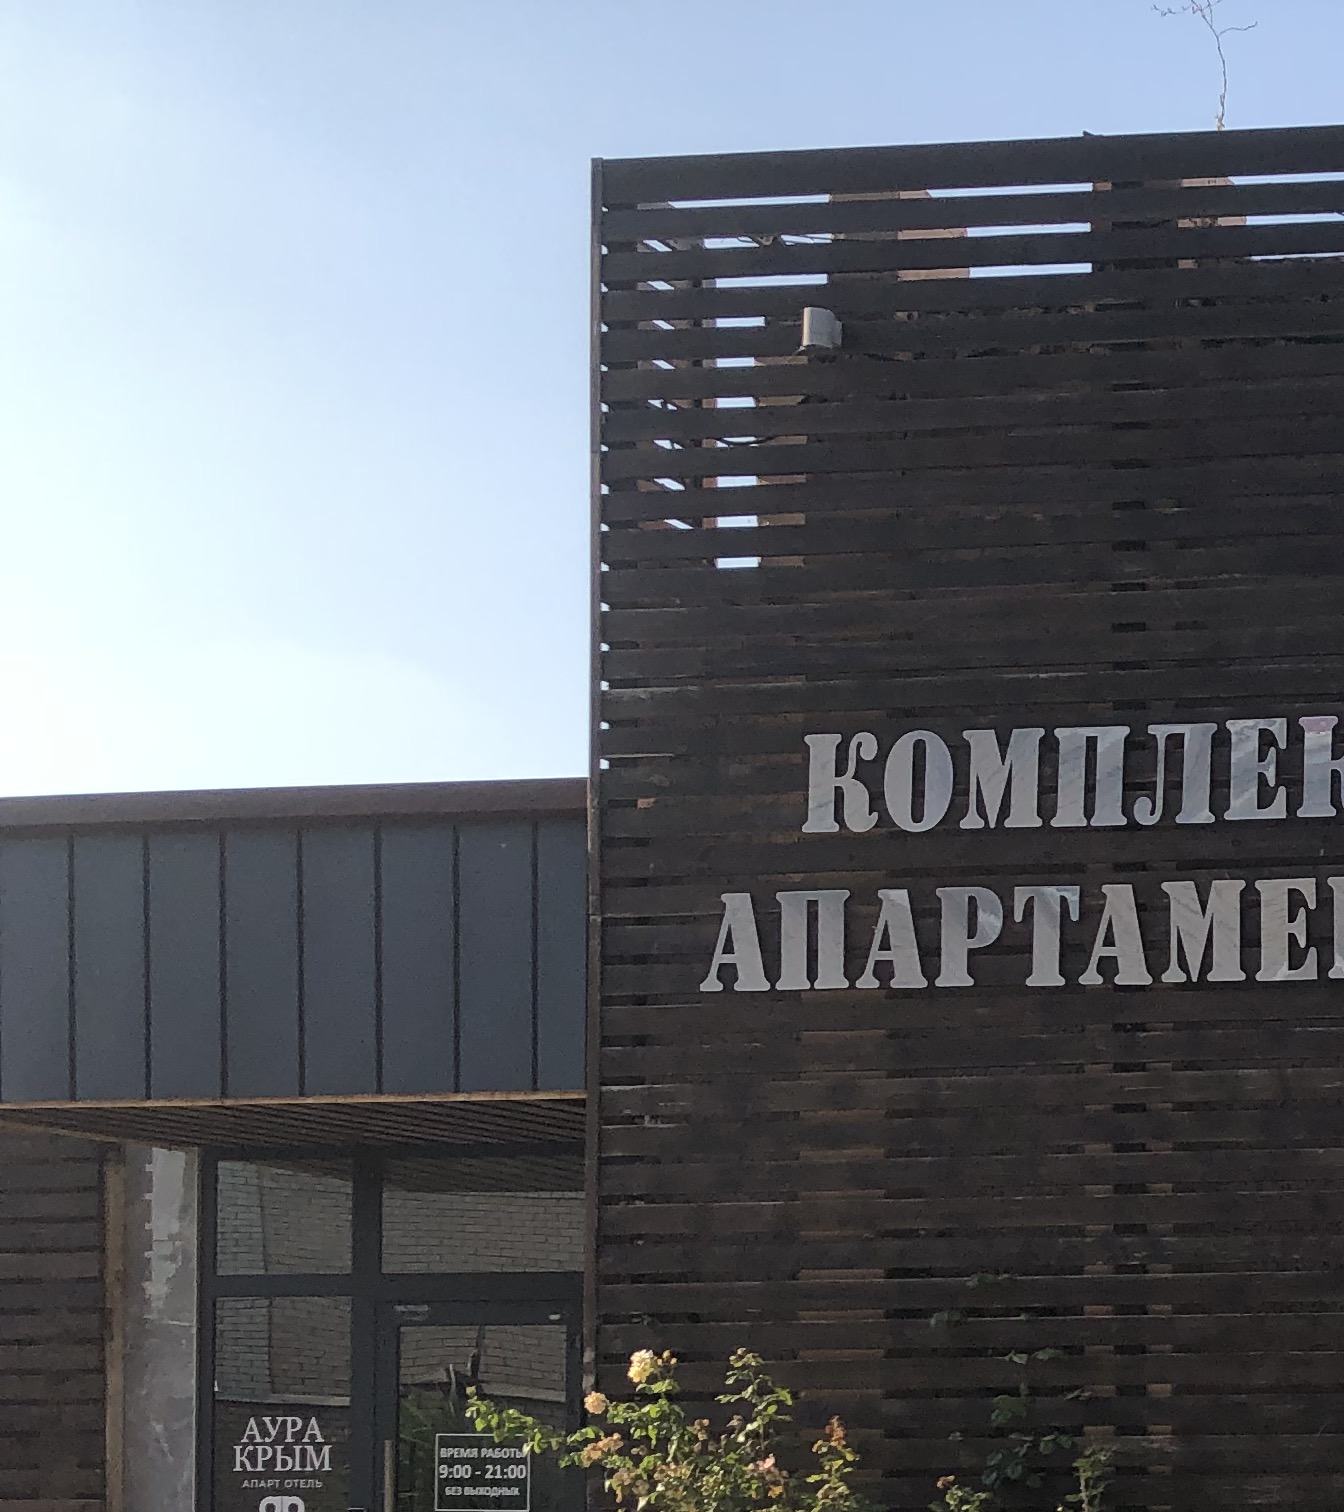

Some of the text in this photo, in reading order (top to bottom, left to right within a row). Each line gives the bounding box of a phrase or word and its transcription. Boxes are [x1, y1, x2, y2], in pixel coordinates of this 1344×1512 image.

[241, 1416, 324, 1443] АУРА
[232, 1445, 332, 1471] КРЫМ
[440, 1447, 478, 1458] ВРЕМЯ
[439, 1465, 472, 1479] 9:00
[485, 1465, 527, 1479] 21:00
[242, 1479, 323, 1488] АПАРТ ОТЕЛЬ
[445, 1486, 462, 1496] БЕЗ
